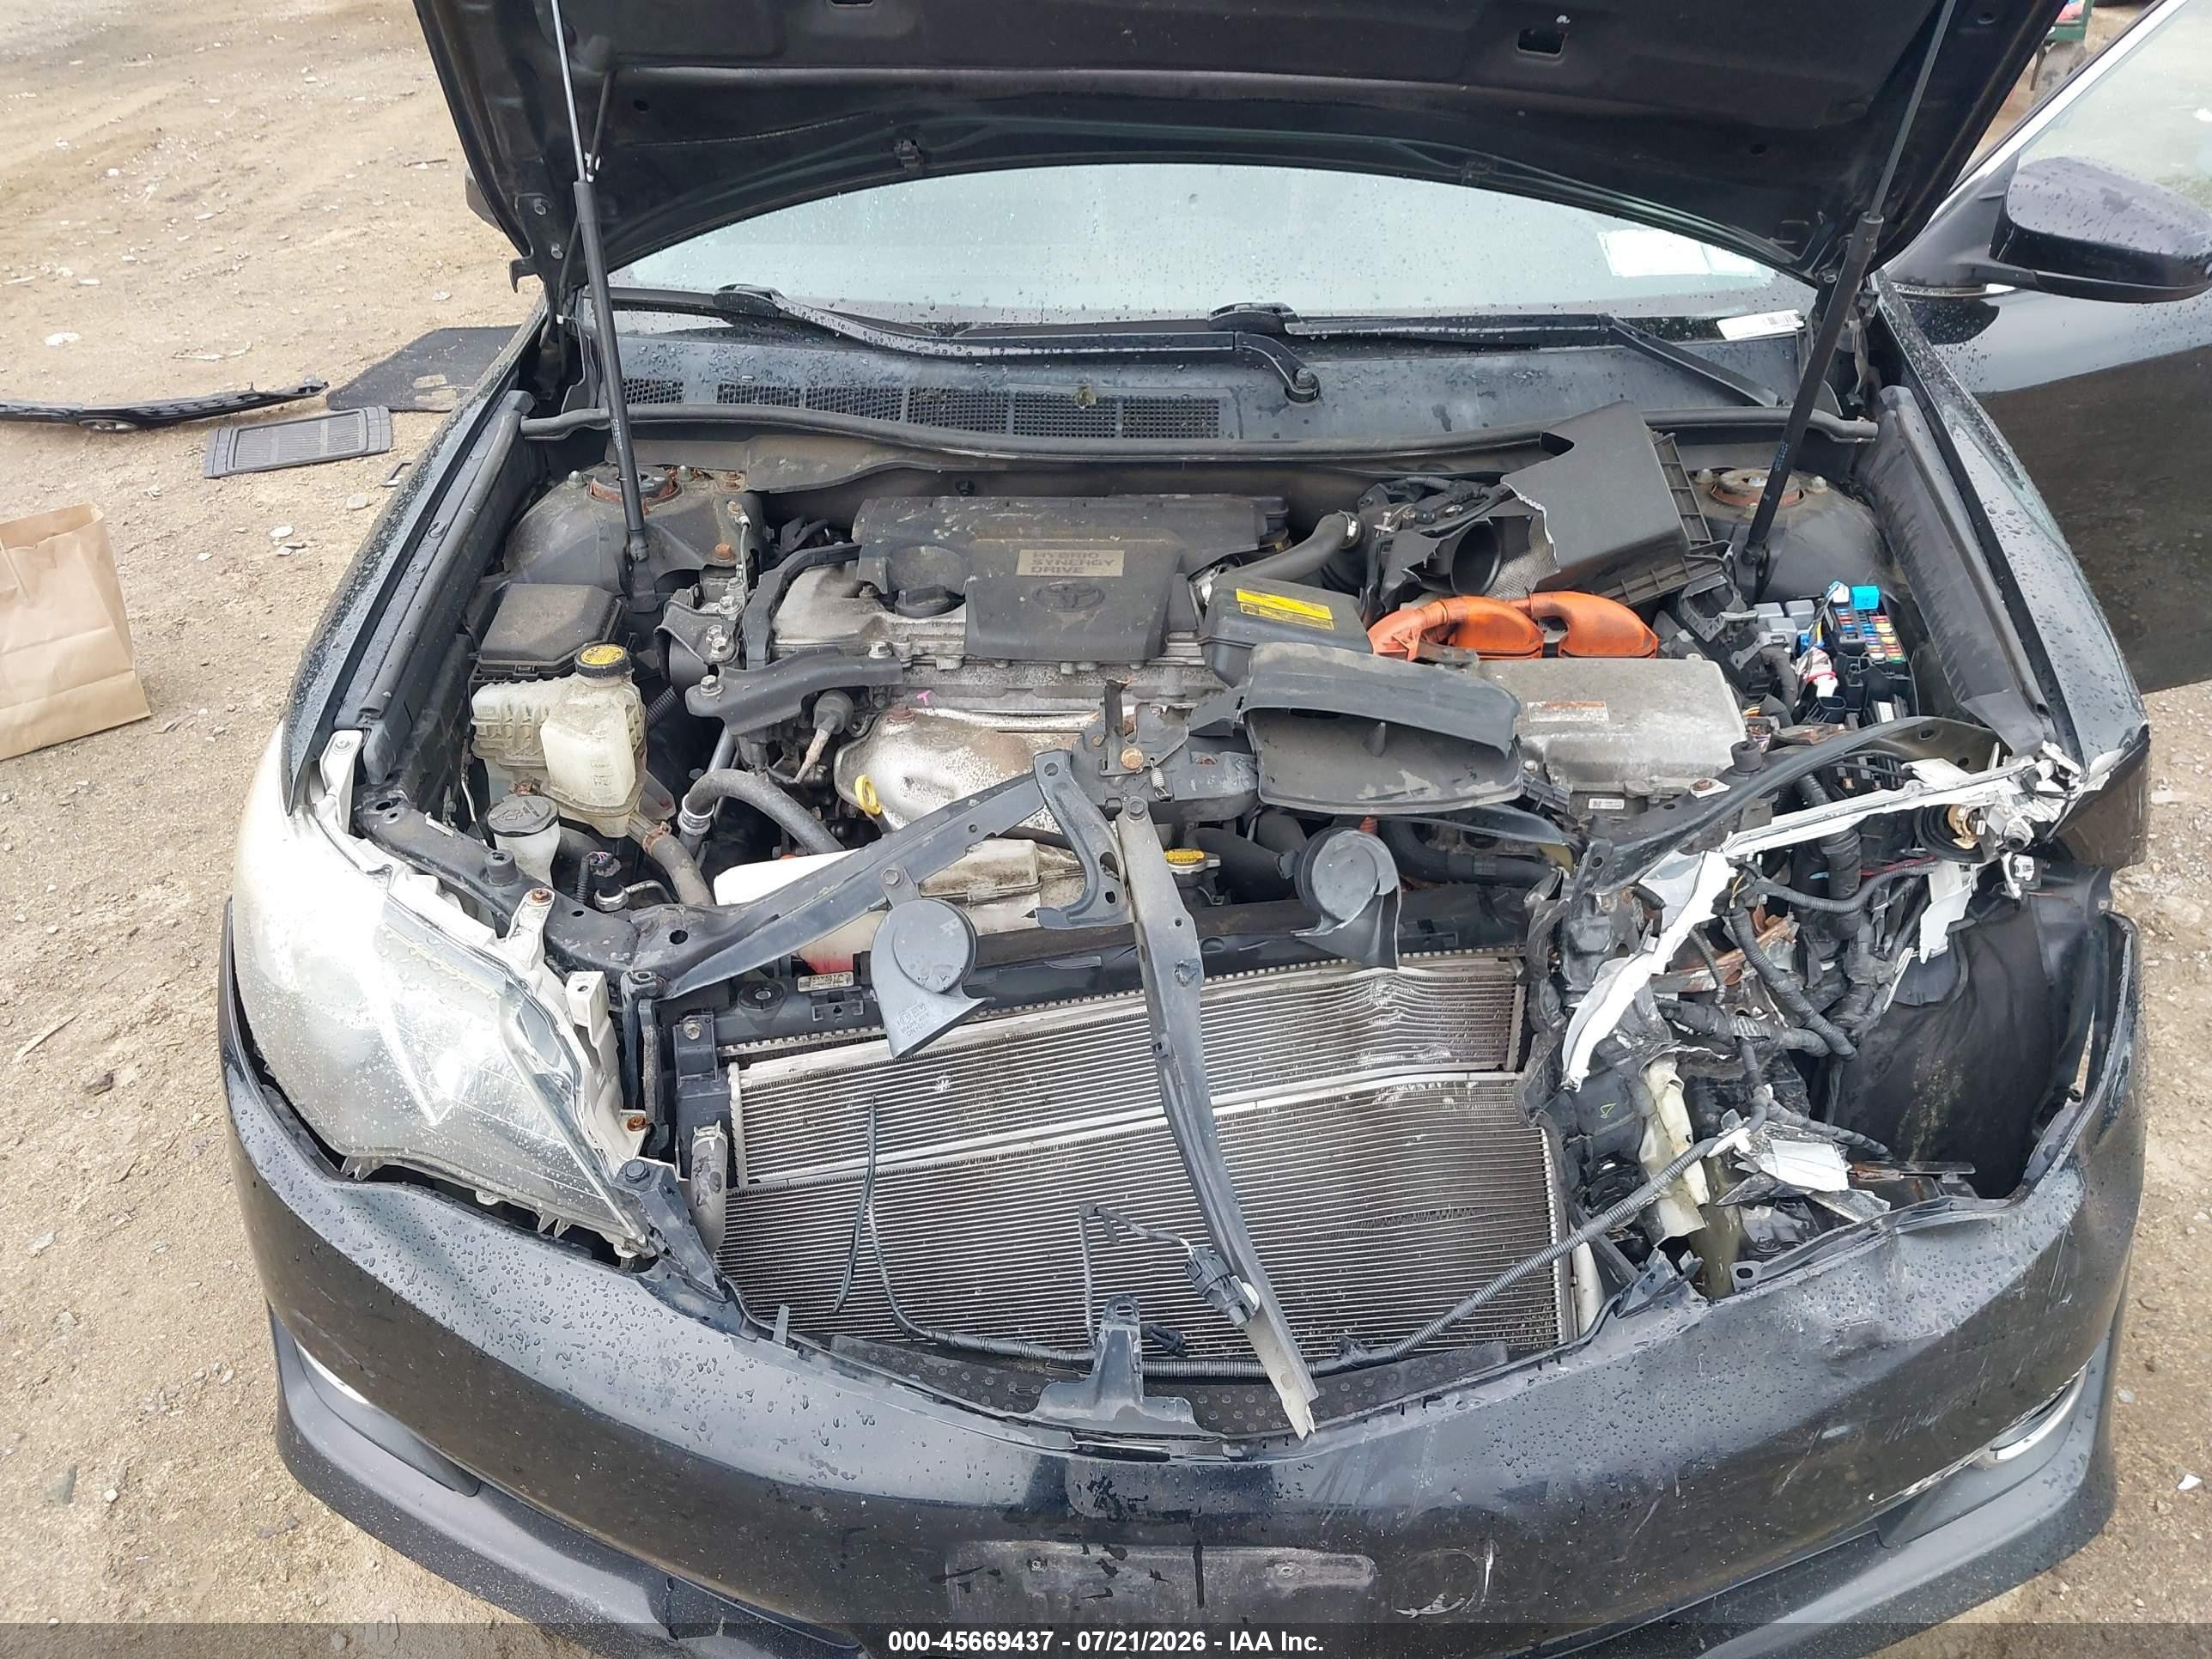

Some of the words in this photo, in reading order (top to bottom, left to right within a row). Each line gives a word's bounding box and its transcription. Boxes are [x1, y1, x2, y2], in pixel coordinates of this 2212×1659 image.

[1033, 550, 1100, 559] HYBRID
[1032, 558, 1115, 567] SYNERGY
[1030, 566, 1085, 574] DRIVE
